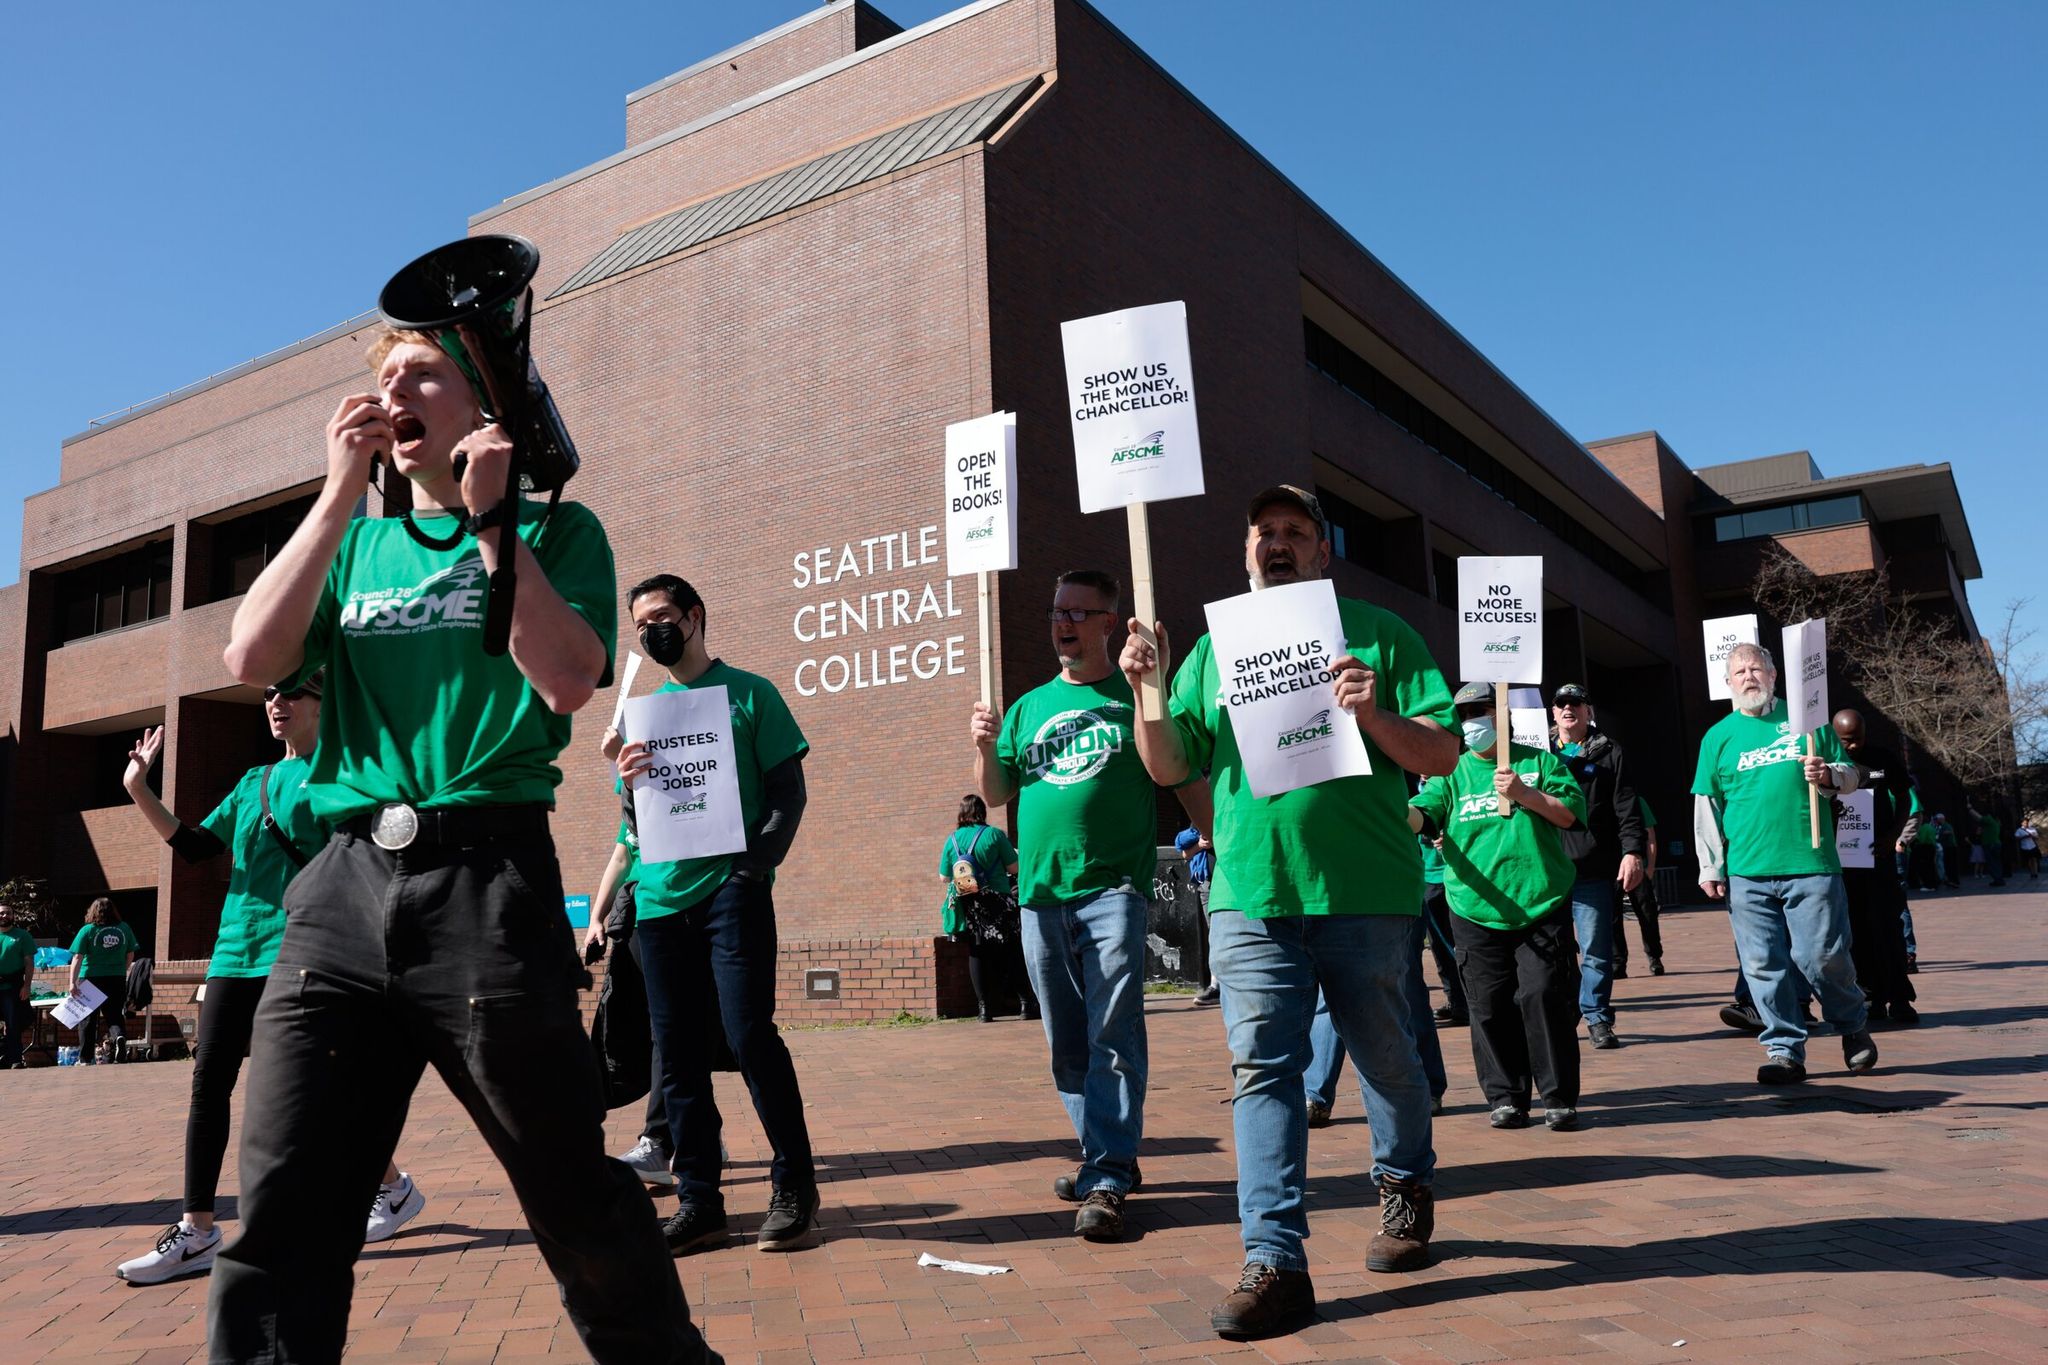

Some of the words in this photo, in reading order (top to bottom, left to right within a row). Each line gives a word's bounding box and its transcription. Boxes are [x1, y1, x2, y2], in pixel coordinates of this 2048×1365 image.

[1084, 367, 1138, 390] SHOW
[1144, 363, 1168, 378] US
[1081, 388, 1111, 405] THE
[1115, 378, 1179, 399] MONEY,
[1075, 390, 1189, 421] CHANCELLOR!
[957, 450, 996, 473] OPEN
[1111, 444, 1164, 463] AFSCME
[963, 472, 991, 491] THE
[952, 489, 1002, 513] BOOKS!
[966, 527, 993, 540] AFSCME
[793, 525, 939, 588] SEATTLE
[350, 588, 393, 600] Council
[397, 587, 412, 598] 28
[1488, 585, 1511, 596] NO
[340, 589, 483, 629] AFSCME
[793, 579, 963, 643] CENTRAL
[1477, 599, 1523, 609] MORE
[420, 624, 437, 632] State
[438, 620, 481, 629] Employees
[1464, 612, 1537, 623] EXCUSES!
[1484, 644, 1520, 652] AFSCME
[1722, 634, 1737, 643] NO
[794, 635, 966, 697] COLLEGE
[1234, 646, 1291, 673] SHOW
[1297, 640, 1322, 656] US
[1233, 671, 1267, 689] THE
[643, 732, 719, 752] RUSTEES:
[1277, 723, 1333, 748] AFSCME
[1025, 724, 1122, 775] UNION
[1736, 745, 1801, 771] AFSCME
[648, 766, 671, 779] DO
[675, 759, 718, 775] YOUR
[1057, 756, 1088, 772] PROUD
[662, 775, 706, 791] JOBS!
[670, 802, 707, 814] AFSCME
[1459, 797, 1499, 816] AFS
[1840, 822, 1871, 830] CUSES!
